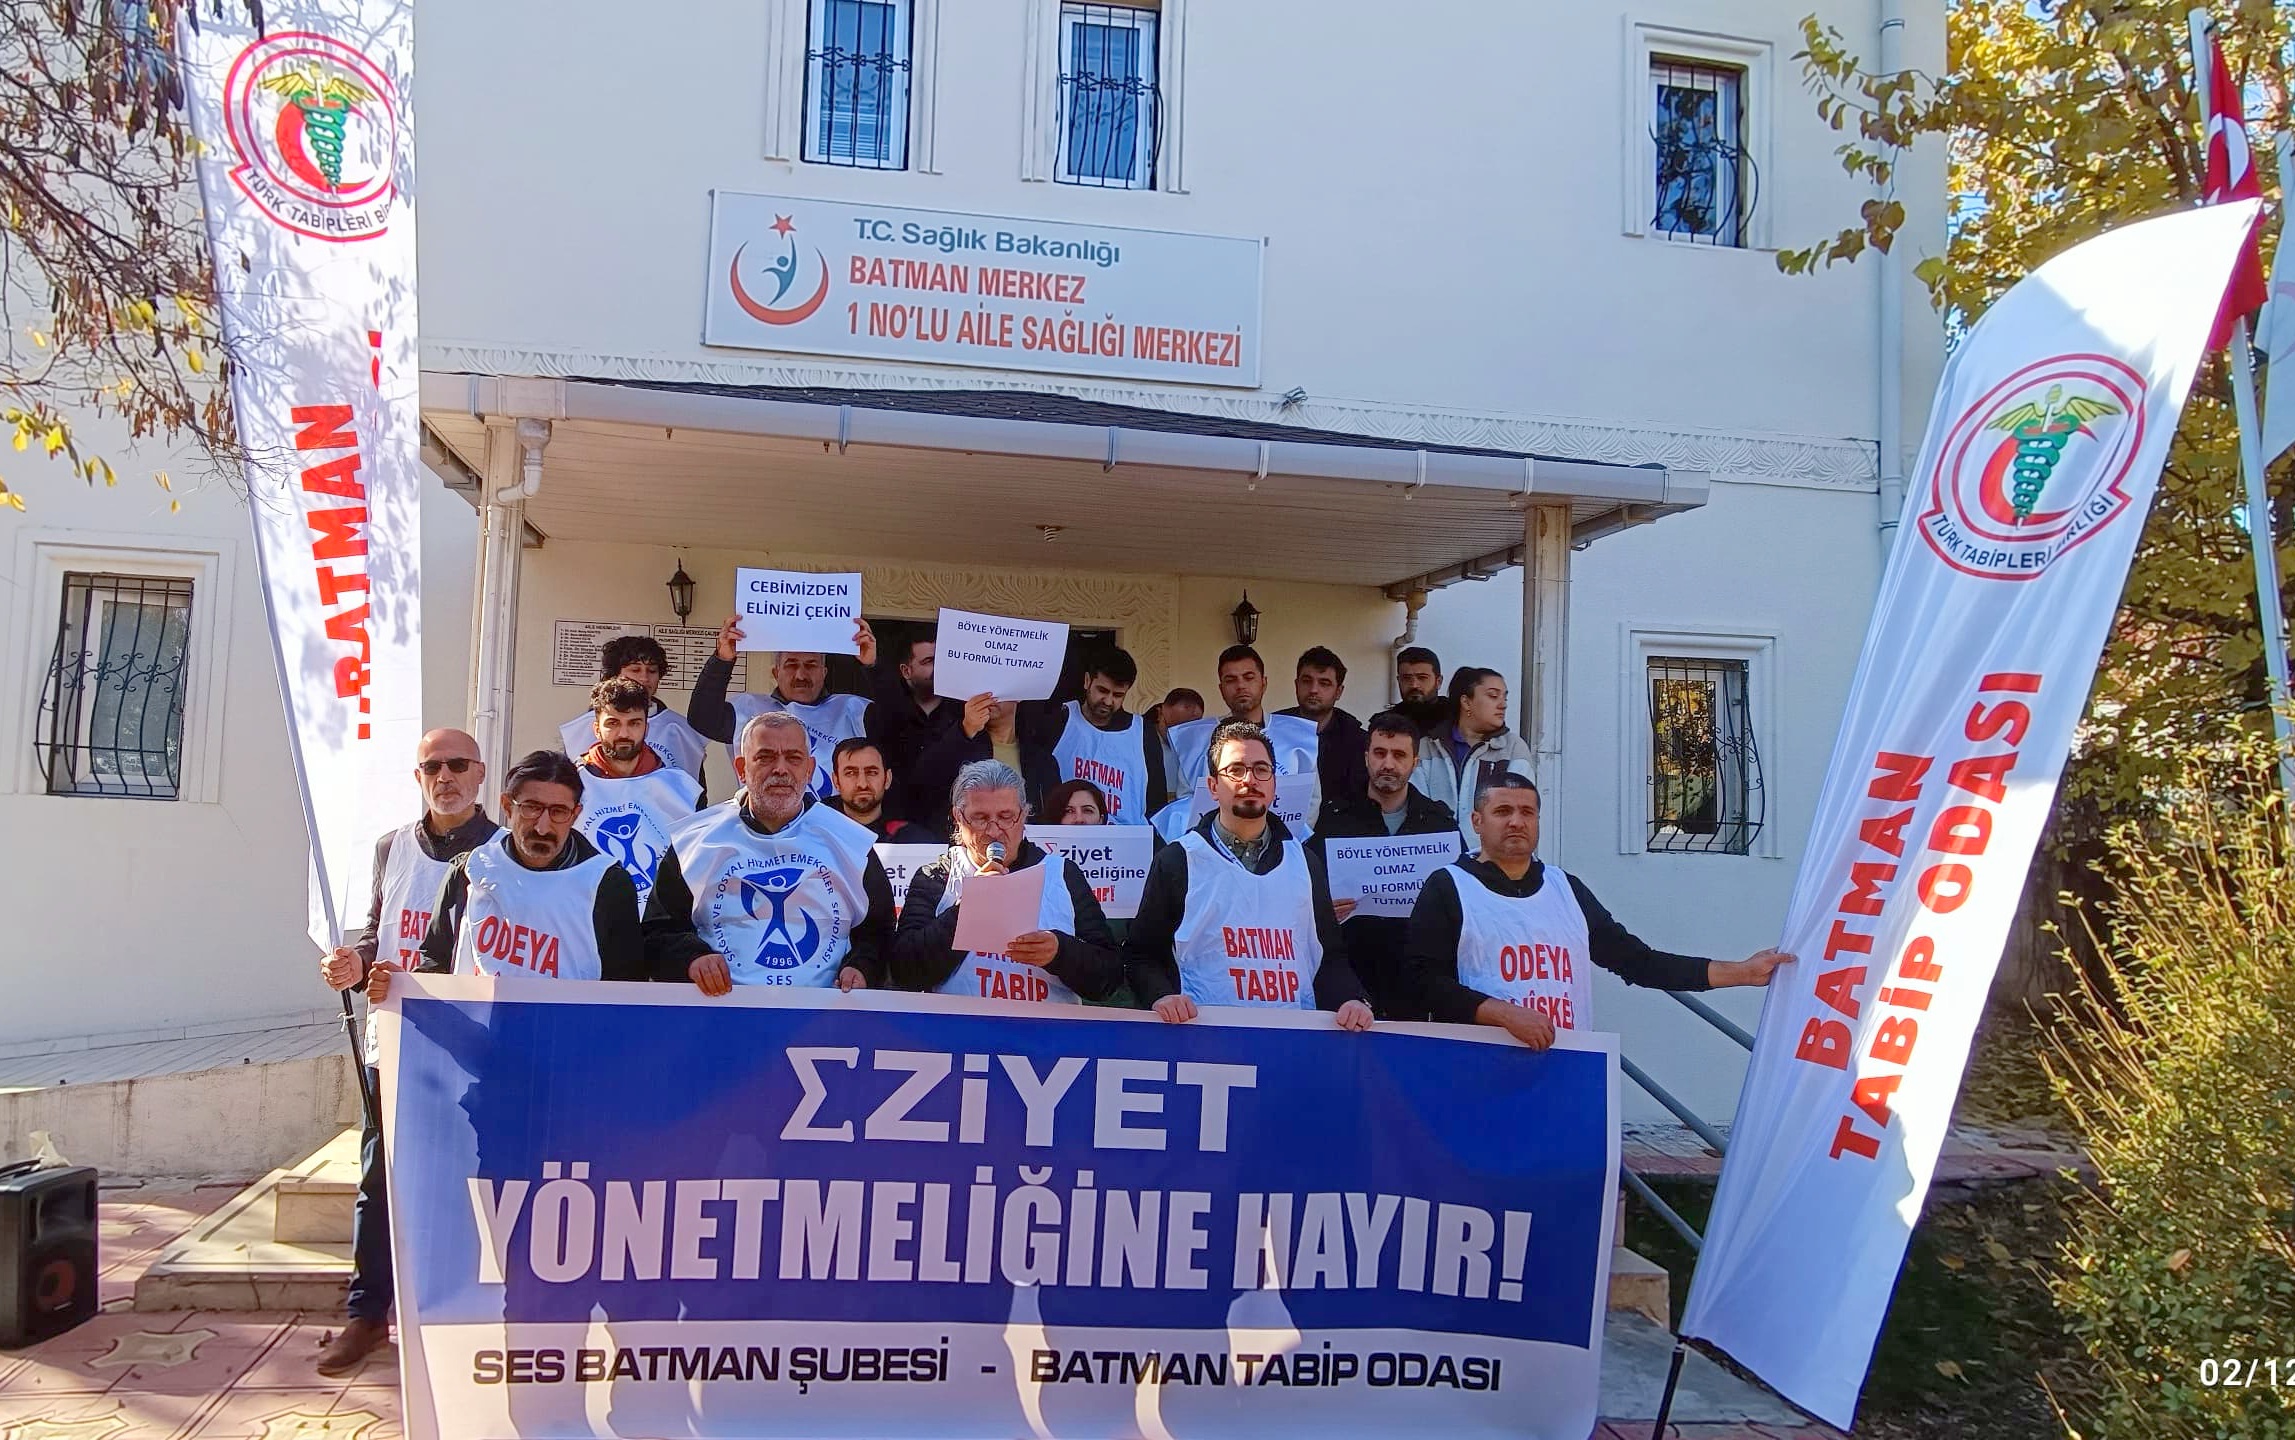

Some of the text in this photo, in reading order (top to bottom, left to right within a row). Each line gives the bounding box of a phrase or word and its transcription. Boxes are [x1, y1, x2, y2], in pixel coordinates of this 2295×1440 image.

[247, 169, 285, 213] TÜRK
[291, 206, 373, 231] TABİPLERİ
[853, 218, 1120, 268] T.C. Sağlık Bakanlığı
[850, 256, 1086, 305] BATMAN MERKEZ
[848, 303, 858, 335] 1
[957, 302, 1014, 348] AİLE
[1022, 309, 1126, 357] SAĞLIĞI
[1133, 324, 1241, 368] MERKEZİ
[1932, 514, 1964, 554] TÜRK
[750, 580, 848, 596] CEBİMİZDEN
[746, 600, 851, 621] ELİNİZİ ÇEKİN
[957, 621, 1049, 641] BÖYLE YÖNETMELİK
[984, 640, 1019, 652] OLMAZ
[947, 649, 1044, 669] BU FORMÜL TUTMAZ
[1074, 757, 1125, 792] BATMAN
[1917, 672, 2043, 914] ODASI
[1337, 841, 1450, 860] BÖYLE YÖNETMELİK
[716, 861, 744, 900] SOSYAL
[1362, 879, 1424, 894] BU FORMÜ
[1373, 863, 1416, 875] OLMAZ
[712, 903, 722, 919] VE
[1371, 897, 1415, 905] TUTMA
[1794, 751, 1935, 1071] BATMAN
[400, 909, 432, 941] BAT
[478, 915, 560, 979] ODEYA
[765, 956, 793, 966] 1996
[1222, 926, 1296, 961] BATMAN
[766, 975, 793, 986] SES
[1500, 944, 1573, 985] ODEYA
[976, 967, 1049, 1002] TABİP
[1229, 963, 1299, 1002] TABİP
[467, 1161, 1533, 1303] YÖNETMELİĞİNE HAYIR!
[473, 1348, 565, 1384] SES
[575, 1346, 780, 1384] BATMAN
[788, 1336, 949, 1395] ŞUBESİ
[1031, 1349, 1227, 1386] BATMAN
[1237, 1340, 1359, 1387] TABİP
[1367, 1354, 1500, 1391] ODASI
